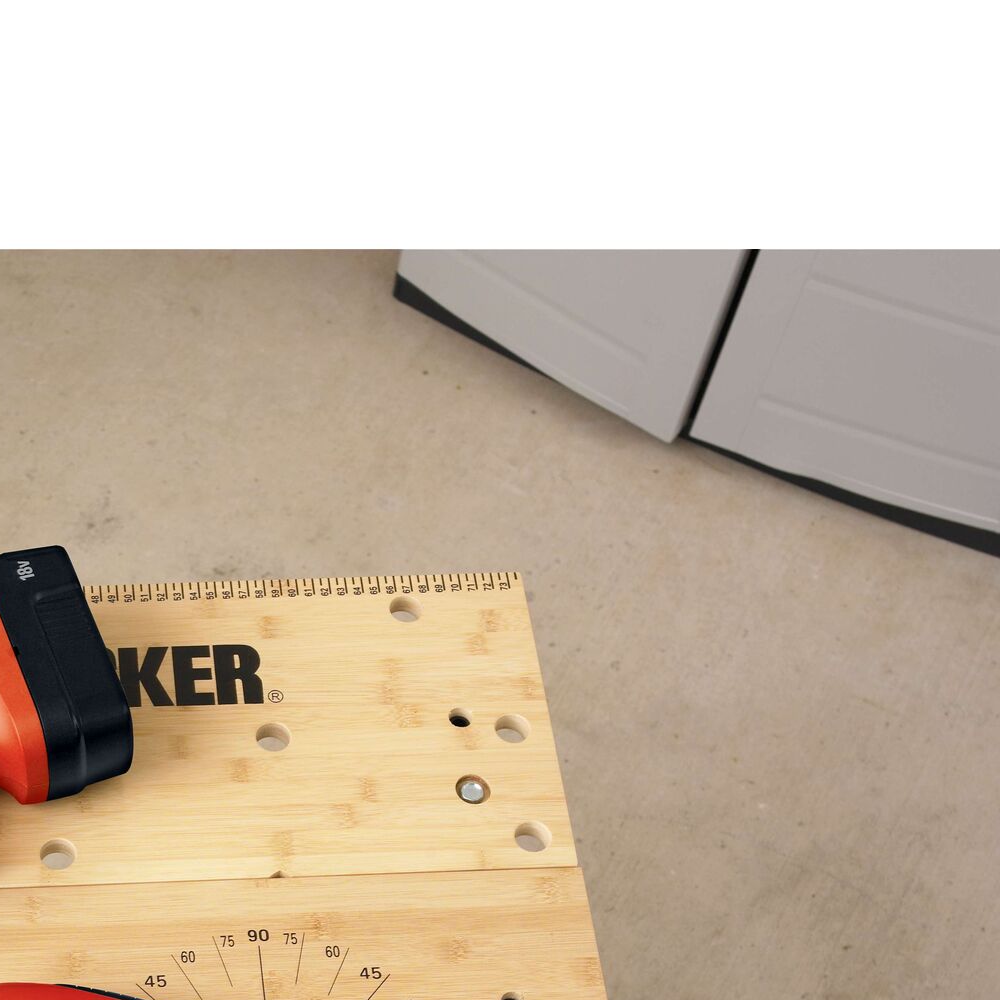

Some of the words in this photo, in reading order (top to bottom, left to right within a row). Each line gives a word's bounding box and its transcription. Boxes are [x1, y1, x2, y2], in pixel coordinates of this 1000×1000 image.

[124, 594, 133, 603] 50
[206, 591, 215, 600] 55
[288, 589, 296, 598] 60
[369, 586, 378, 595] 65
[451, 583, 460, 592] 70
[500, 582, 508, 591] 73
[106, 644, 264, 707] KER
[220, 935, 235, 948] 75
[247, 928, 270, 942] 90
[283, 932, 298, 946] 75
[180, 950, 196, 964] 60
[325, 945, 340, 959] 60
[359, 967, 382, 980] 45
[144, 974, 168, 988] 45
